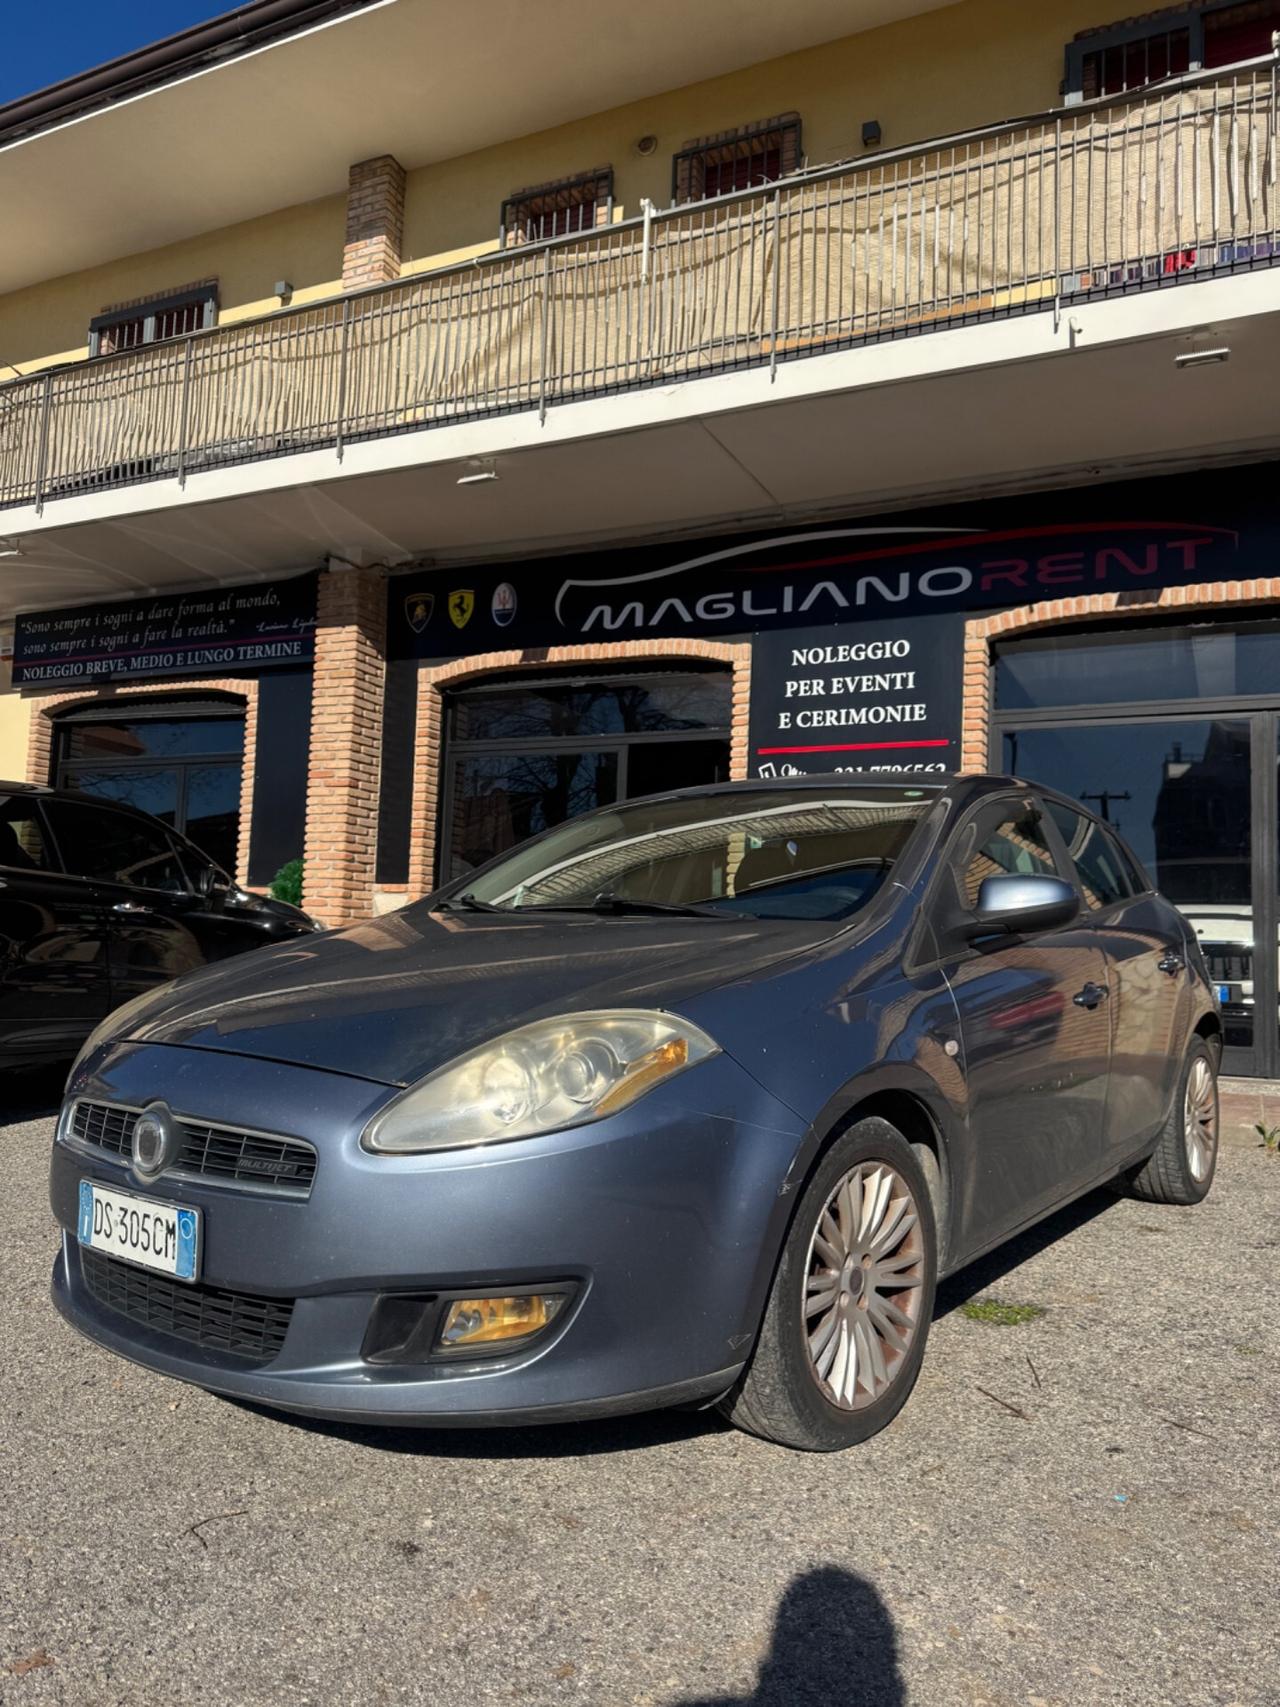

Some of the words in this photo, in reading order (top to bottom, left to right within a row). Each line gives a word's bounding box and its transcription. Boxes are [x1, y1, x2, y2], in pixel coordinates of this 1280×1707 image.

[53, 615, 91, 636] sempre
[103, 608, 134, 631] sogni
[136, 609, 145, 622] a
[148, 600, 174, 621] dare
[175, 597, 215, 625] forma
[217, 592, 235, 612] al
[235, 586, 281, 609] mondo,
[23, 642, 47, 656] sono
[49, 638, 87, 657] sempre
[98, 631, 129, 653] sogni
[132, 632, 140, 645] a
[139, 624, 168, 649] fare
[170, 621, 183, 640] la
[791, 639, 911, 666] NOLEGGIO
[22, 662, 84, 681] NOLEGGIO
[85, 657, 129, 676] BREVE,
[130, 653, 174, 672] MEDIO
[175, 651, 185, 667] E
[185, 647, 235, 666] LUNGO
[237, 641, 302, 661] TERMINE
[784, 679, 826, 698] PER
[830, 671, 916, 695] EVENTI
[777, 712, 792, 729] E
[796, 703, 927, 728] CERIMONIE
